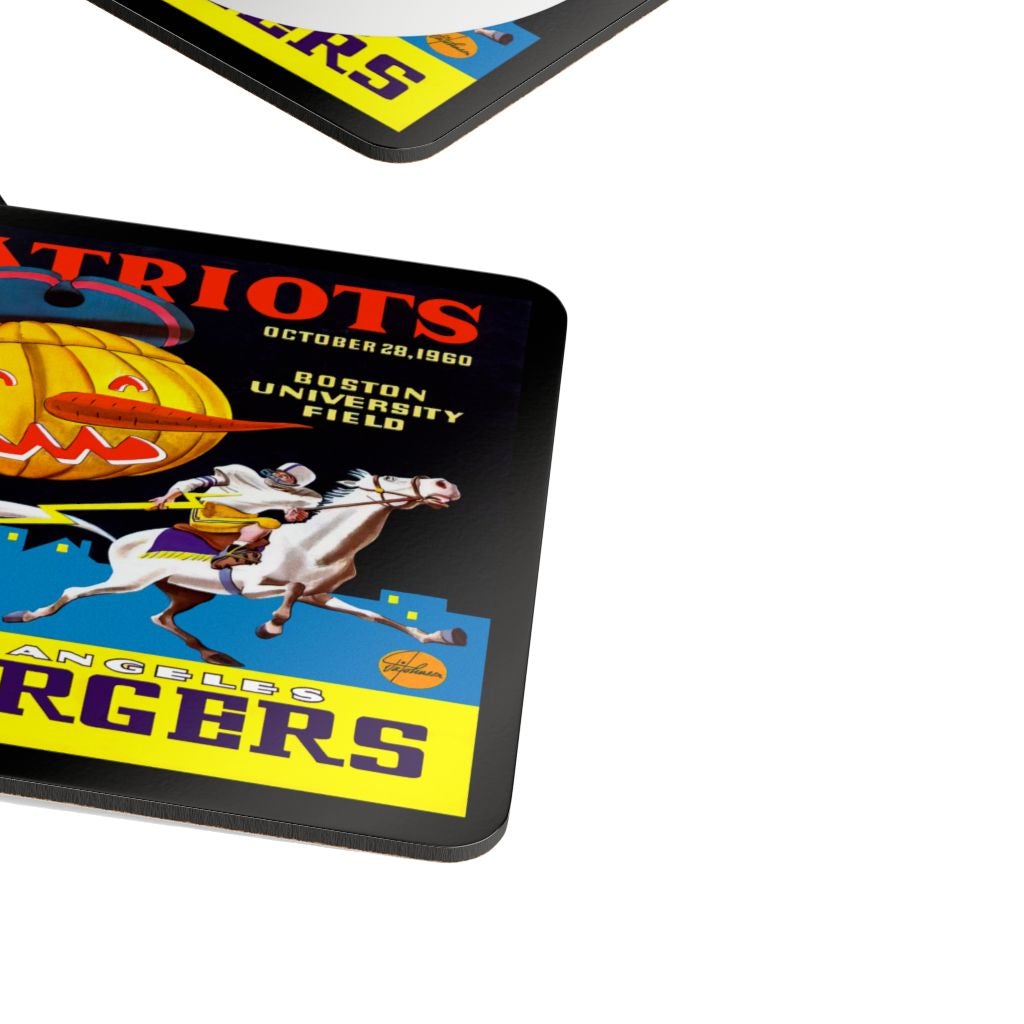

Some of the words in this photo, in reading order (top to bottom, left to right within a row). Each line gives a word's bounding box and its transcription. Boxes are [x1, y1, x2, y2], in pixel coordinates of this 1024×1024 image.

[263, 326, 376, 353] OCTOBER
[380, 343, 472, 367] 28,1960
[250, 380, 464, 423] UNIVERSITY
[294, 371, 426, 402] BOSTON
[303, 405, 405, 431] FIELD
[5, 642, 326, 703] ANGELES
